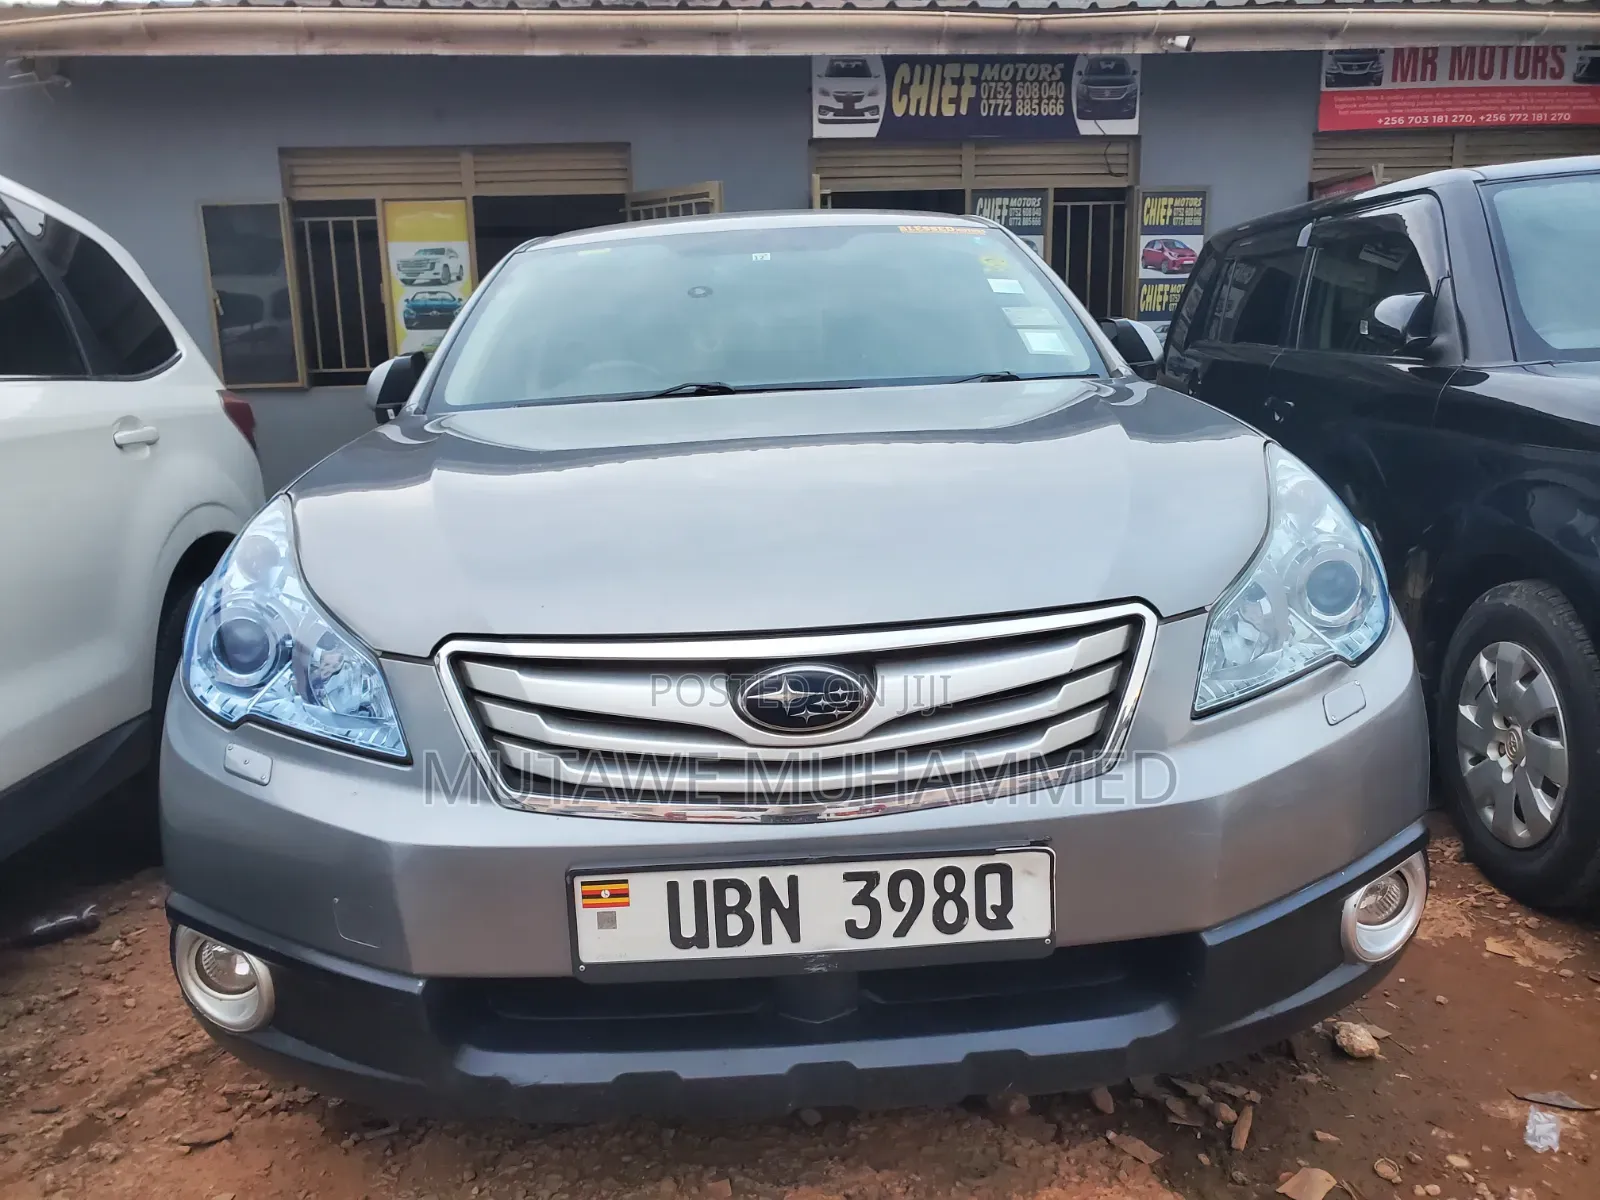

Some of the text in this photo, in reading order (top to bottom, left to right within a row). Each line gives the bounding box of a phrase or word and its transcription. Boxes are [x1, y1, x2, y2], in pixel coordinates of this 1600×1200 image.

[1391, 46, 1566, 82] MR MOTORS
[892, 63, 1064, 117] CHIEF MOTORS
[981, 82, 1065, 98] 0752 608 040
[981, 99, 1064, 116] 0772 885 666
[1378, 112, 1571, 125] +256 703 181 270, +256 772 181 270
[1010, 198, 1041, 207] MOTORS
[1144, 197, 1174, 226] CHIEF
[1140, 284, 1186, 312] CHIEF MOT
[666, 862, 1015, 950] UBN 398Q
